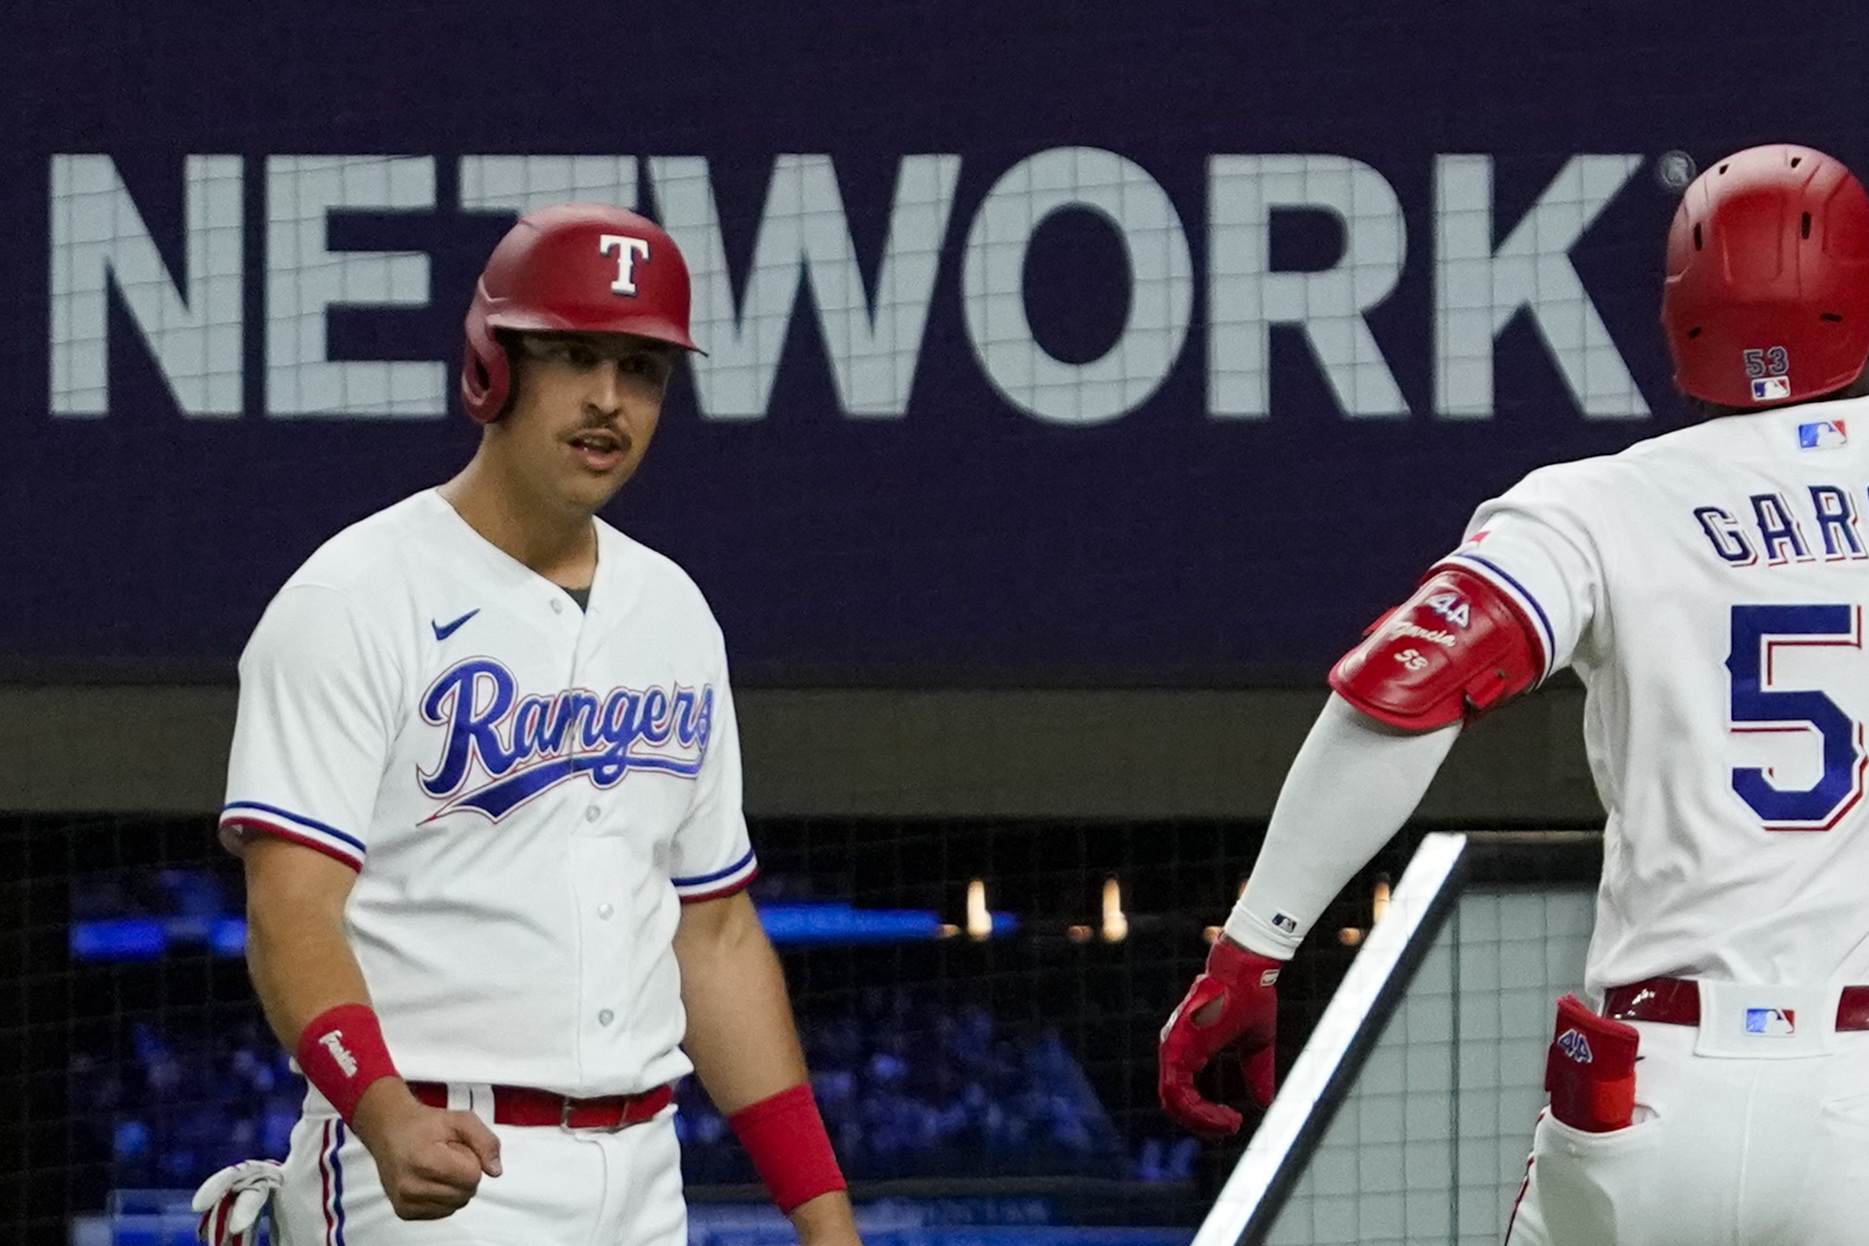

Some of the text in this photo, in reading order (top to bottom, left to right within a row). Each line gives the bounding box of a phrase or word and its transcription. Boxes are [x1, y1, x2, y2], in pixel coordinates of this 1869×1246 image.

[599, 234, 649, 297] T
[1743, 346, 1790, 378] 53
[416, 655, 715, 810] Rangers
